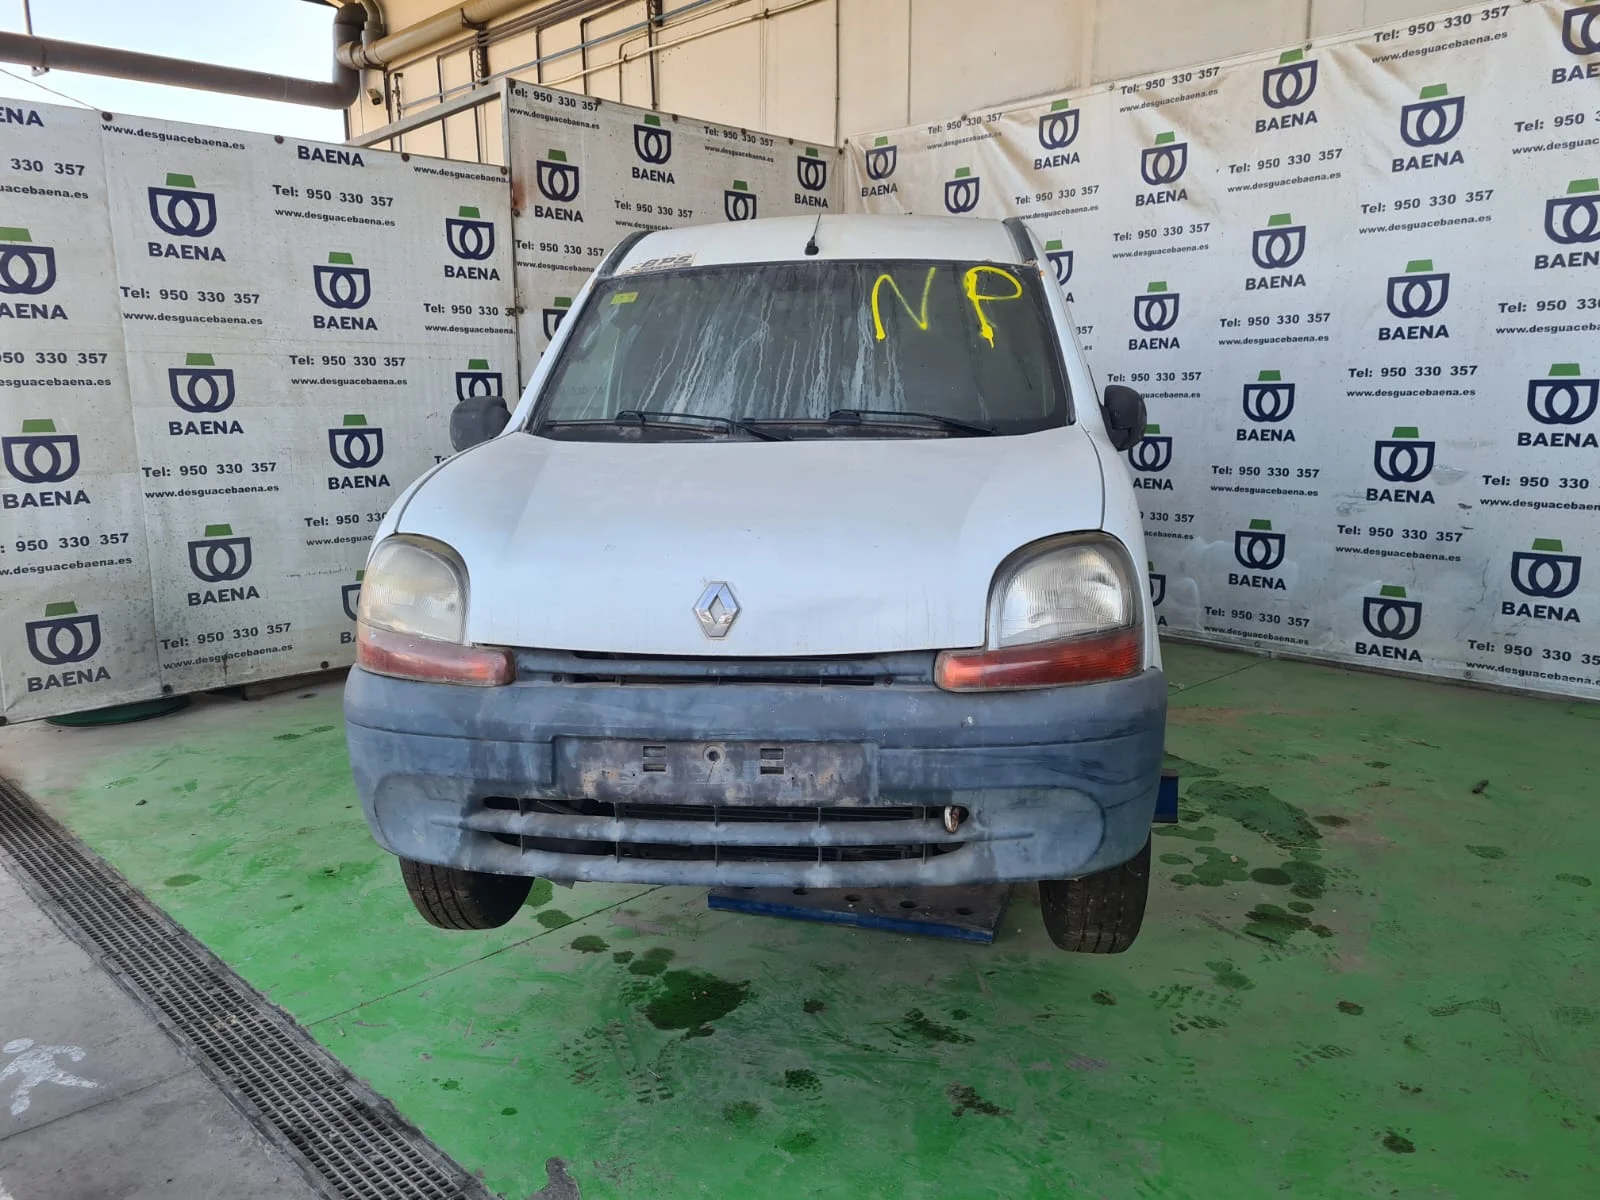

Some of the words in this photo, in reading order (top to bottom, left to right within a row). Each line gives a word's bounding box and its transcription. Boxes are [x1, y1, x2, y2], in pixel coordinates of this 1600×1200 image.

[1374, 29, 1399, 42] Tel:
[1408, 21, 1435, 35] 950
[1443, 13, 1472, 28] 330
[1481, 5, 1510, 21] 357
[1372, 30, 1507, 63] www.desguacebaena.es
[1120, 84, 1140, 95] Tel:
[1145, 78, 1165, 90] 950
[1172, 72, 1192, 84] 330
[1198, 66, 1220, 79] 357
[509, 87, 527, 98] Tel:
[533, 91, 552, 103] 950
[558, 96, 576, 107] 330
[582, 100, 599, 111] 357
[928, 125, 942, 134] Tel:
[947, 121, 962, 130] 950
[966, 117, 982, 126] 330
[986, 112, 1003, 123] 357
[1256, 111, 1318, 133] BAENA
[1514, 120, 1544, 132] Tel:
[1554, 113, 1584, 127] 950
[101, 123, 245, 150] www.desguacebaena.es
[704, 126, 719, 136] Tel:
[723, 130, 738, 140] 950
[741, 134, 756, 143] 330
[760, 137, 773, 147] 357
[298, 145, 364, 167] BAENA
[1034, 152, 1080, 170] BAENA
[1229, 163, 1250, 174] Tel:
[1258, 158, 1280, 170] 950
[1288, 153, 1311, 165] 330
[1319, 148, 1343, 161] 357
[1392, 150, 1464, 172] BAENA
[11, 159, 43, 172] 330
[54, 163, 85, 176] 357
[632, 167, 675, 184] BAENA
[862, 183, 897, 197] BAENA
[1227, 172, 1341, 192] www.desguacebaena.es
[272, 185, 298, 197] Tel:
[307, 189, 331, 200] 950
[340, 192, 363, 204] 330
[371, 196, 393, 207] 357
[795, 193, 828, 208] BAENA
[1015, 195, 1030, 205] Tel:
[1036, 192, 1052, 202] 950
[1058, 189, 1076, 199] 330
[1082, 185, 1099, 195] 357
[1136, 189, 1188, 206] BAENA
[1361, 202, 1385, 214] Tel:
[1394, 198, 1420, 210] 950
[1430, 194, 1456, 206] 330
[1466, 189, 1493, 202] 357
[275, 209, 395, 226] www.desguacebaena.es
[535, 205, 583, 222] BAENA
[615, 200, 631, 210] Tel:
[637, 203, 652, 213] 950
[657, 206, 673, 216] 330
[678, 209, 693, 218] 357
[1113, 232, 1132, 241] Tel:
[1138, 229, 1157, 239] 950
[1163, 226, 1183, 236] 330
[1190, 223, 1210, 233] 357
[1359, 216, 1491, 234] www.desguacebaena.es
[148, 242, 226, 262] BAENA
[515, 240, 534, 250] Tel:
[540, 243, 558, 252] 950
[564, 245, 581, 255] 330
[587, 247, 604, 257] 357
[444, 265, 500, 281] BAENA
[1246, 274, 1306, 290] BAENA
[120, 286, 150, 298] Tel:
[160, 289, 188, 300] 950
[198, 291, 225, 302] 330
[234, 293, 259, 304] 357
[424, 303, 445, 313] Tel:
[451, 305, 472, 314] 950
[479, 306, 498, 316] 330
[1498, 302, 1526, 313] Tel:
[1537, 300, 1566, 311] 950
[123, 313, 263, 324] www.desguacebaena.es
[313, 315, 378, 330] BAENA
[1220, 318, 1240, 327] Tel:
[1248, 316, 1270, 326] 950
[1277, 314, 1299, 324] 330
[1307, 313, 1330, 323] 357
[1219, 333, 1329, 345] www.desguacebaena.es
[1379, 325, 1449, 340] BAENA
[1129, 337, 1180, 350] BAENA
[36, 352, 67, 363] 330
[78, 353, 107, 364] 357
[289, 355, 314, 365] Tel:
[322, 356, 346, 365] 950
[354, 356, 376, 366] 330
[384, 357, 405, 366] 357
[1107, 374, 1125, 382] Tel:
[1131, 373, 1149, 382] 950
[1156, 372, 1175, 381] 330
[1182, 372, 1201, 381] 357
[1348, 368, 1372, 377] Tel:
[1381, 367, 1406, 377] 950
[1415, 367, 1441, 376] 330
[1450, 365, 1478, 376] 357
[291, 377, 407, 386] www.desguacebaena.es
[1347, 389, 1475, 398] www.desguacebaena.es
[169, 421, 244, 435] BAENA
[1237, 429, 1295, 441] BAENA
[1518, 432, 1598, 447] BAENA
[142, 467, 171, 477] Tel:
[180, 465, 207, 476] 950
[217, 464, 242, 474] 330
[252, 462, 276, 472] 357
[1212, 466, 1232, 474] Tel:
[1239, 466, 1260, 476] 950
[1268, 467, 1289, 477] 330
[1297, 468, 1319, 478] 357
[328, 475, 390, 490] BAENA
[1211, 485, 1318, 496] www.desguacebaena.es
[1482, 475, 1510, 485] Tel:
[1520, 477, 1549, 487] 950
[1559, 478, 1589, 489] 330
[3, 490, 91, 509] BAENA
[145, 486, 279, 498] www.desguacebaena.es
[1366, 488, 1435, 504] BAENA
[304, 517, 328, 527] Tel:
[336, 514, 359, 525] 950
[1150, 512, 1168, 521] 330
[1175, 514, 1194, 523] 357
[1337, 525, 1360, 535] Tel:
[1369, 527, 1393, 537] 950
[1402, 529, 1427, 540] 330
[1436, 532, 1463, 542] 357
[16, 539, 48, 552] 950
[59, 536, 89, 548] 330
[100, 533, 128, 544] 357
[1336, 547, 1461, 561] www.desguacebaena.es
[1229, 573, 1286, 590] BAENA
[188, 586, 260, 606] BAENA
[1204, 606, 1225, 616] Tel:
[1231, 610, 1252, 620] 950
[1259, 613, 1280, 624] 330
[1288, 617, 1310, 627] 357
[1502, 602, 1580, 622] BAENA
[160, 637, 189, 649] Tel:
[197, 632, 224, 644] 950
[233, 627, 258, 639] 330
[267, 623, 291, 634] 357
[1203, 626, 1309, 646] www.desguacebaena.es
[163, 642, 293, 670] www.desguacebaena.es
[1355, 642, 1423, 662] BAENA
[1468, 640, 1494, 652] Tel:
[1504, 644, 1532, 656] 950
[1542, 649, 1571, 661] 330
[27, 667, 111, 692] BAENA
